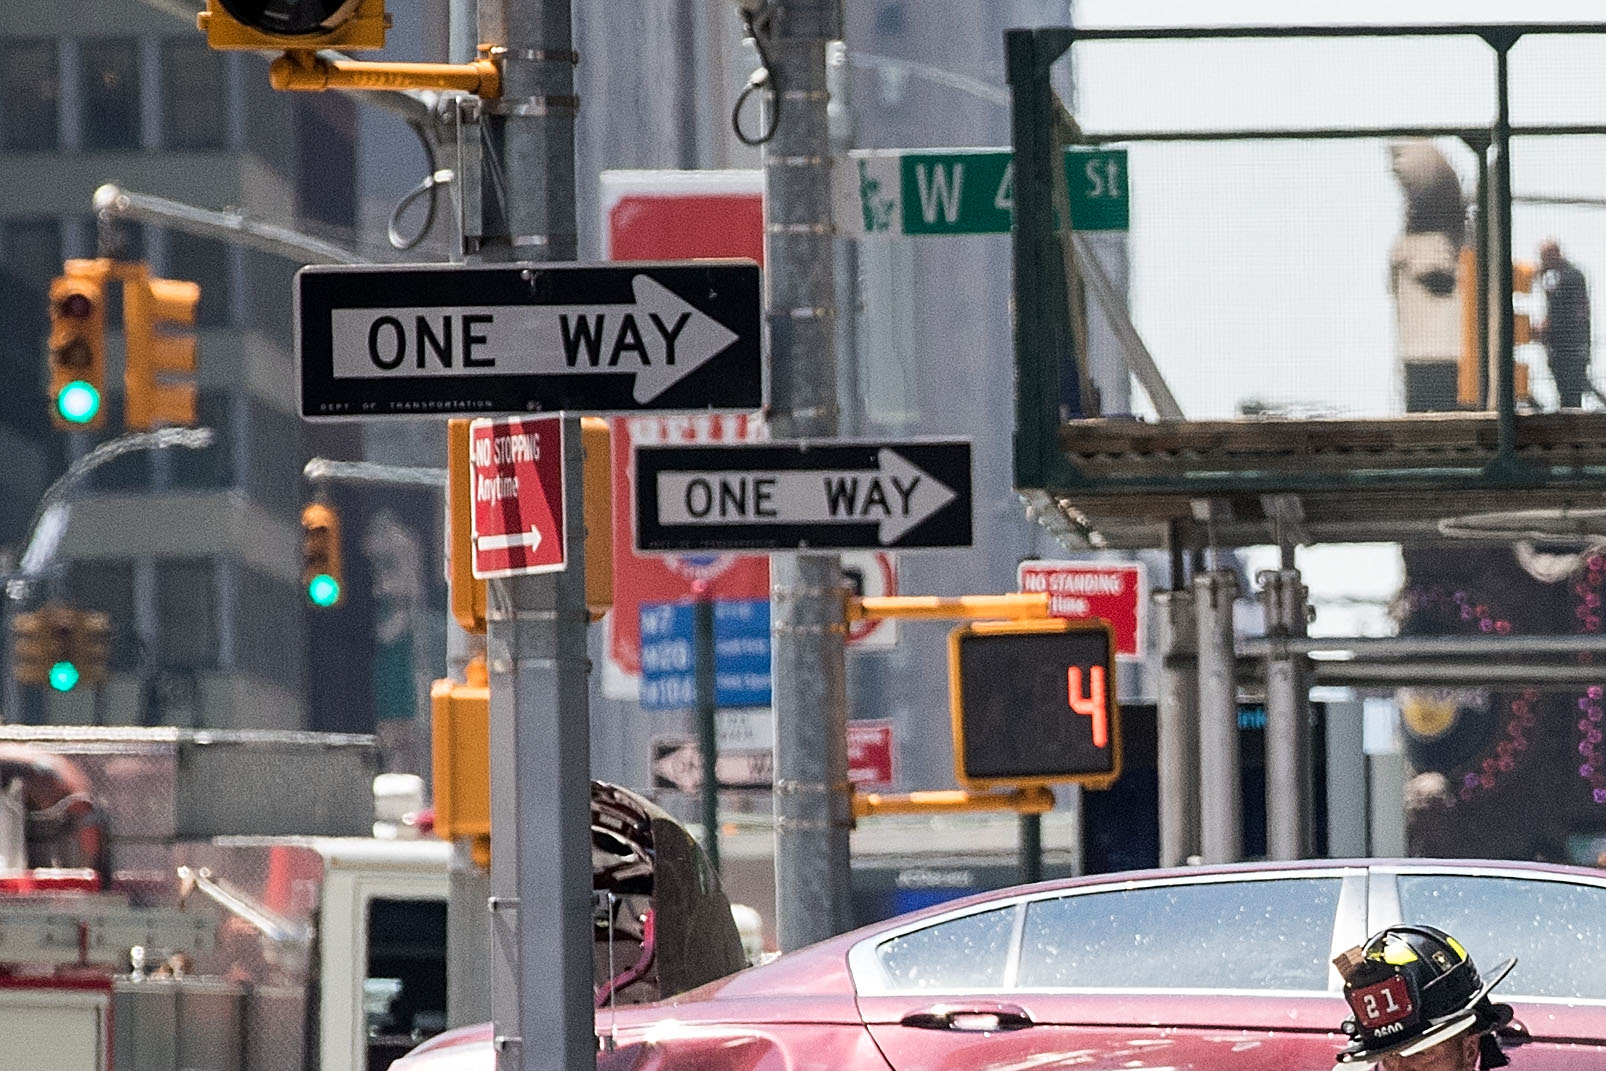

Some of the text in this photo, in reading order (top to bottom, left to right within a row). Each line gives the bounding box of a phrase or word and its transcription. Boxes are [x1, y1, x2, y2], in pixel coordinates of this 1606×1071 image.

[915, 162, 964, 225] W
[1085, 158, 1121, 199] St
[368, 312, 692, 371] ONE WAY
[476, 432, 541, 468] NO STOPPING
[477, 472, 519, 507] Anytime
[685, 475, 921, 519] ONE WAY
[1025, 572, 1122, 593] NO STANDING
[1067, 664, 1108, 749] 4
[1363, 988, 1400, 1019] 21
